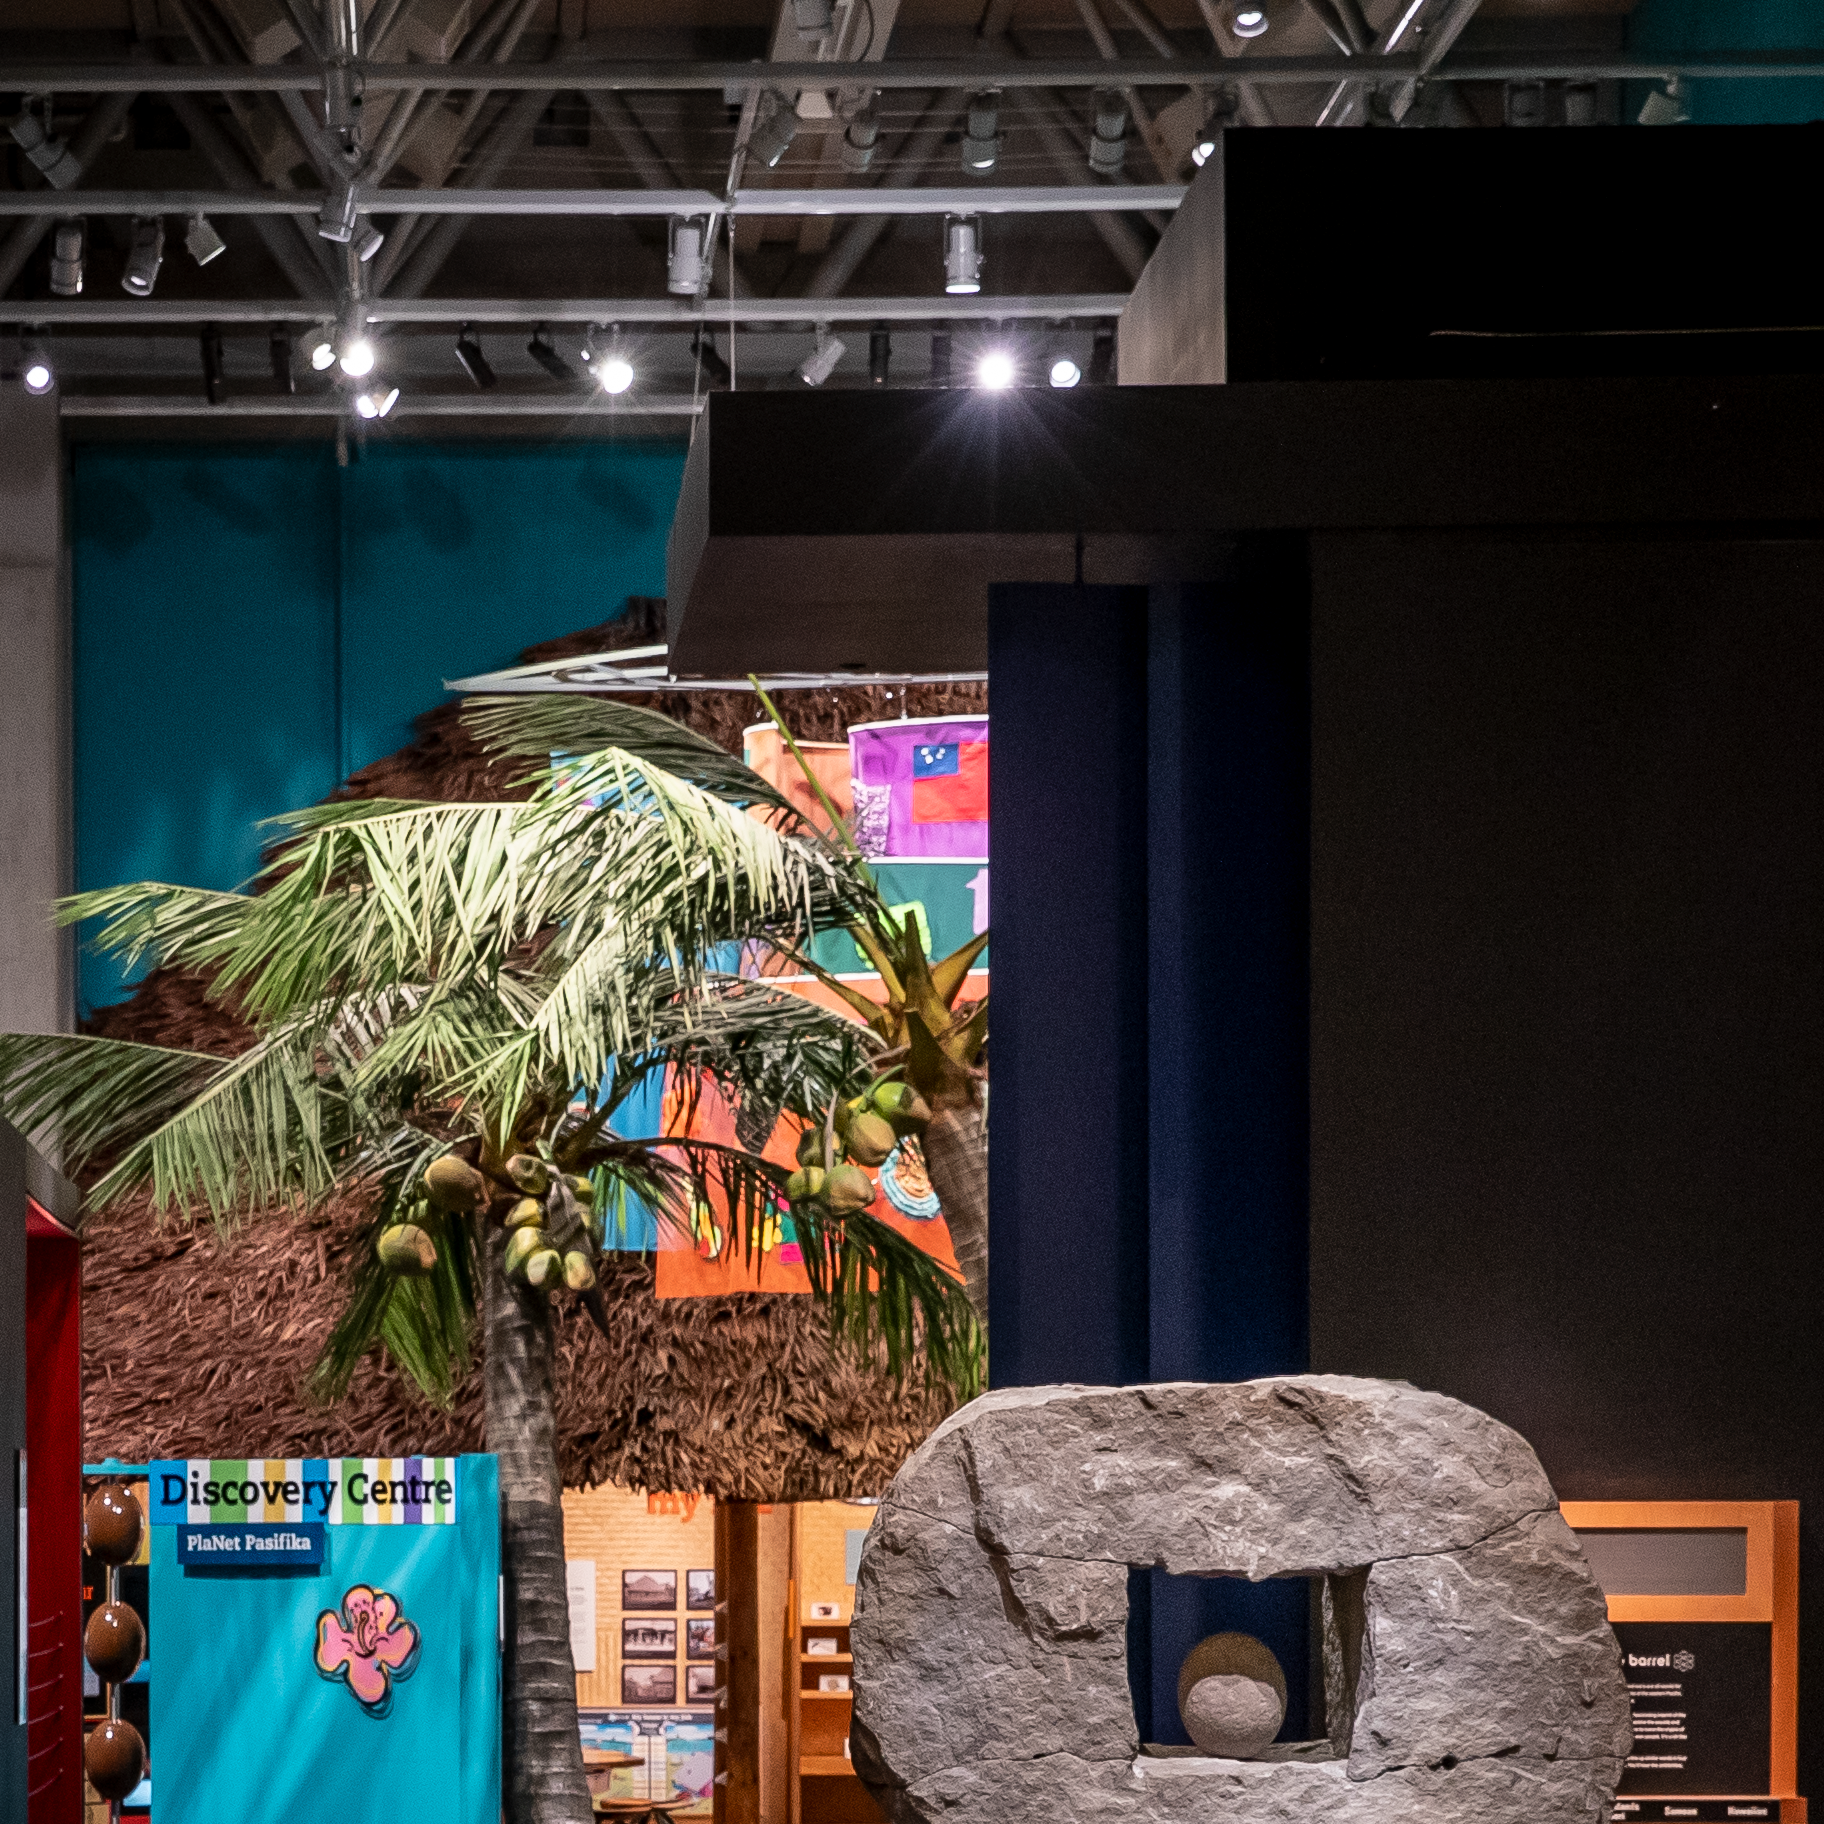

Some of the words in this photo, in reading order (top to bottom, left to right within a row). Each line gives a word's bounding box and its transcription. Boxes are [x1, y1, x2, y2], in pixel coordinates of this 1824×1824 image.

[160, 1470, 338, 1517] Discovery
[347, 1473, 454, 1506] Centre
[186, 1533, 241, 1551] PlaNet
[244, 1533, 312, 1551] Pasifika
[1628, 1653, 1671, 1667] barrel
